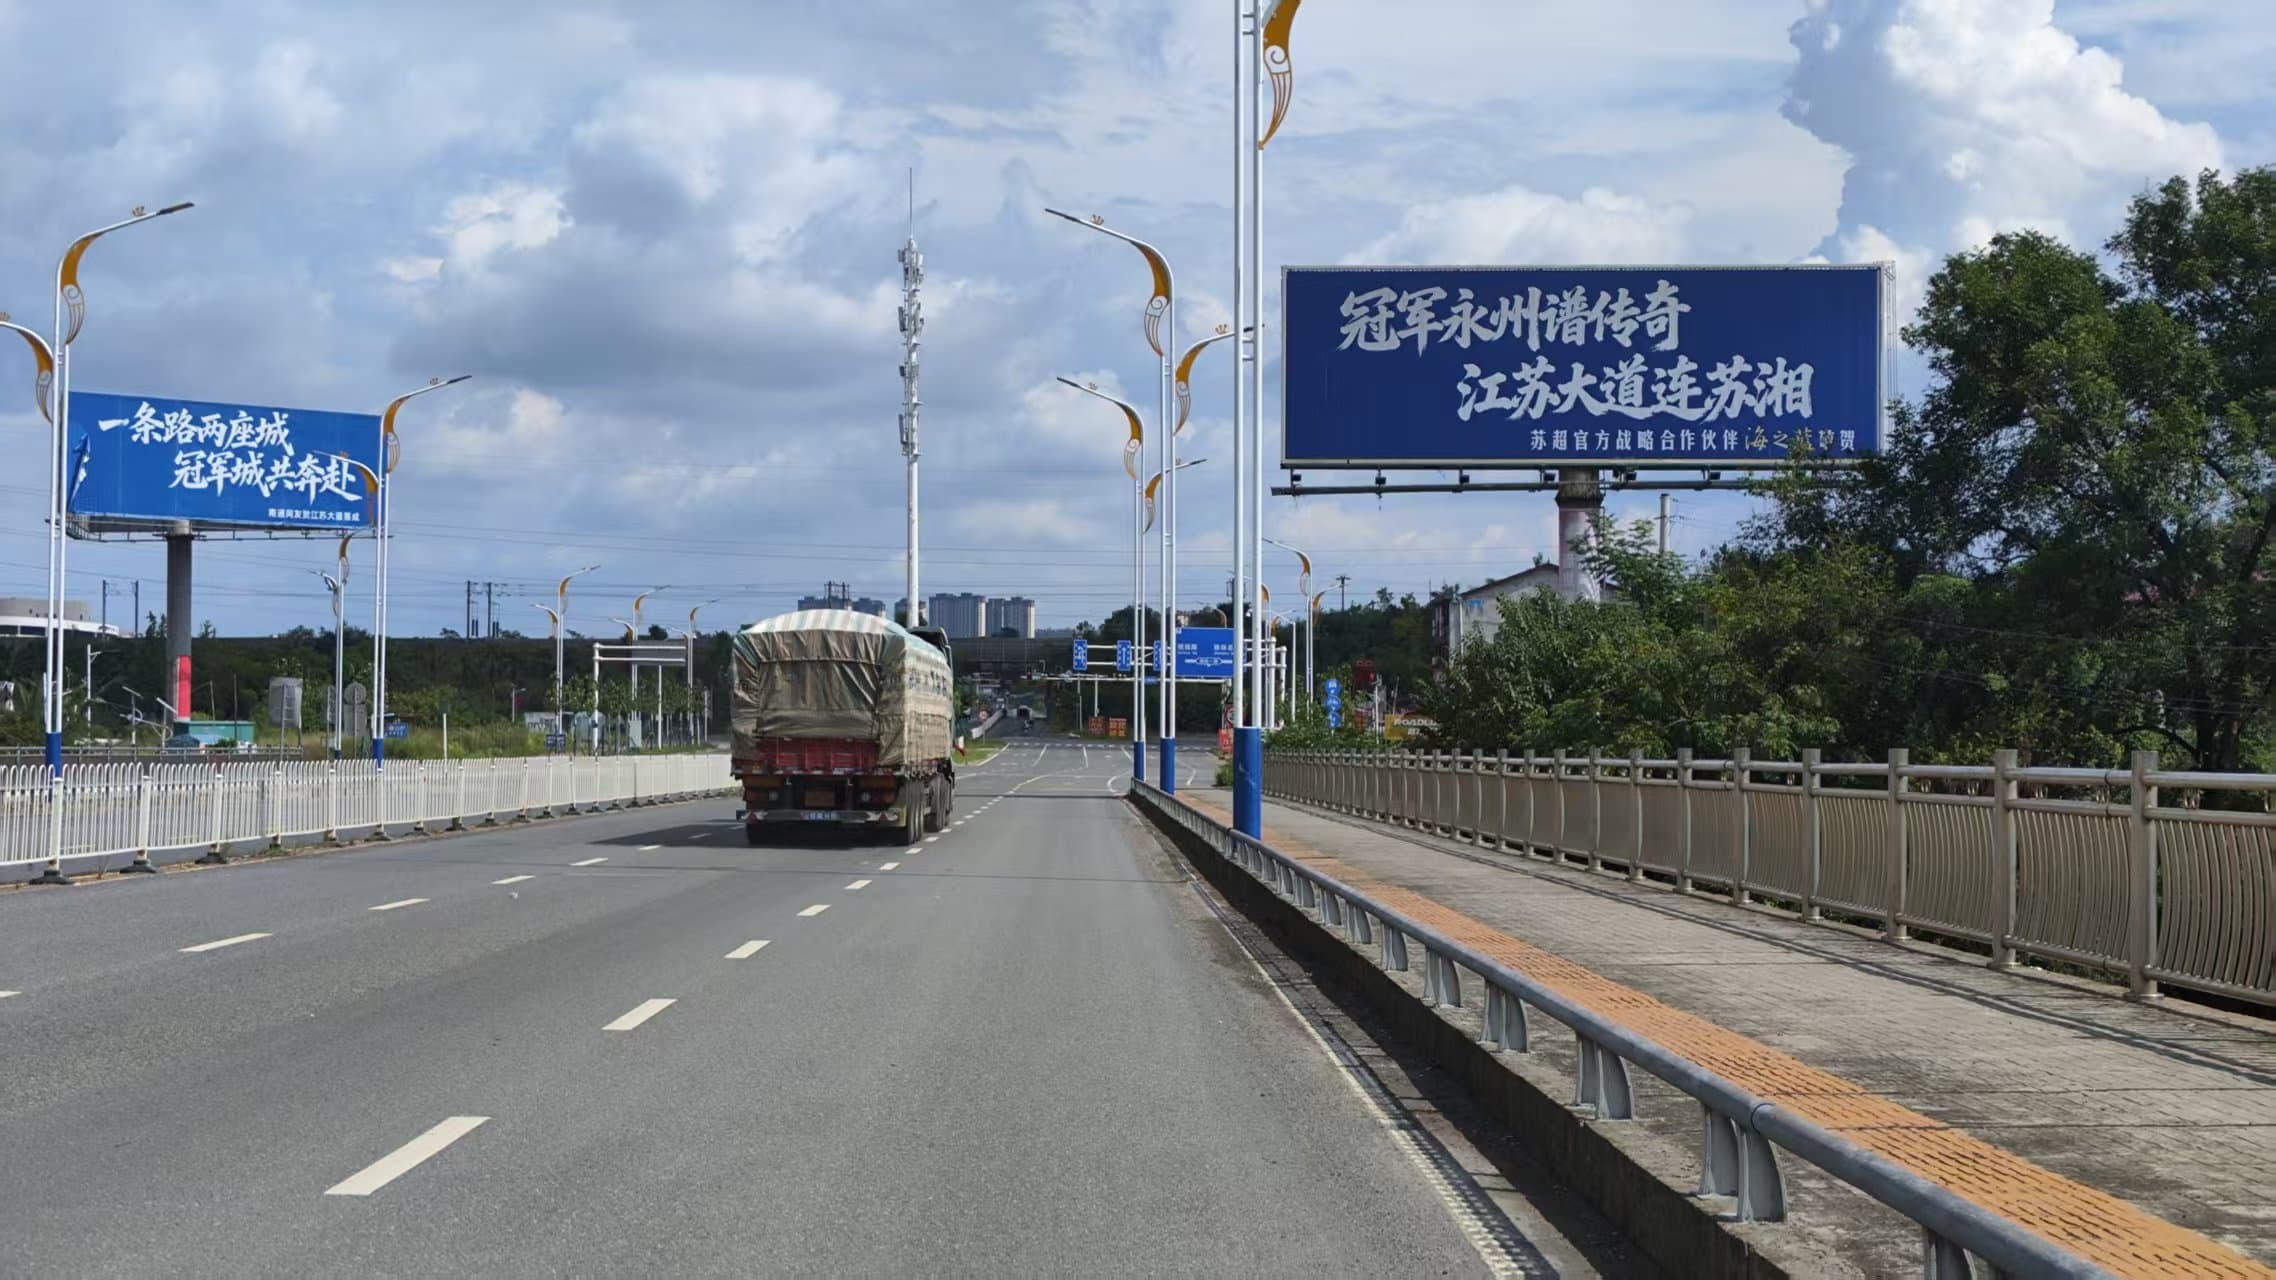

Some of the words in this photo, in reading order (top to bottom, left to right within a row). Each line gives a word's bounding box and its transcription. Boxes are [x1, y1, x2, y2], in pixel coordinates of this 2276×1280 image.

[1338, 280, 1691, 356] 冠军永州谱传奇
[1457, 354, 1814, 422] 江苏大道连苏湘
[98, 401, 294, 456] 一条路两座城
[168, 450, 363, 505] 冠军城共奔赴
